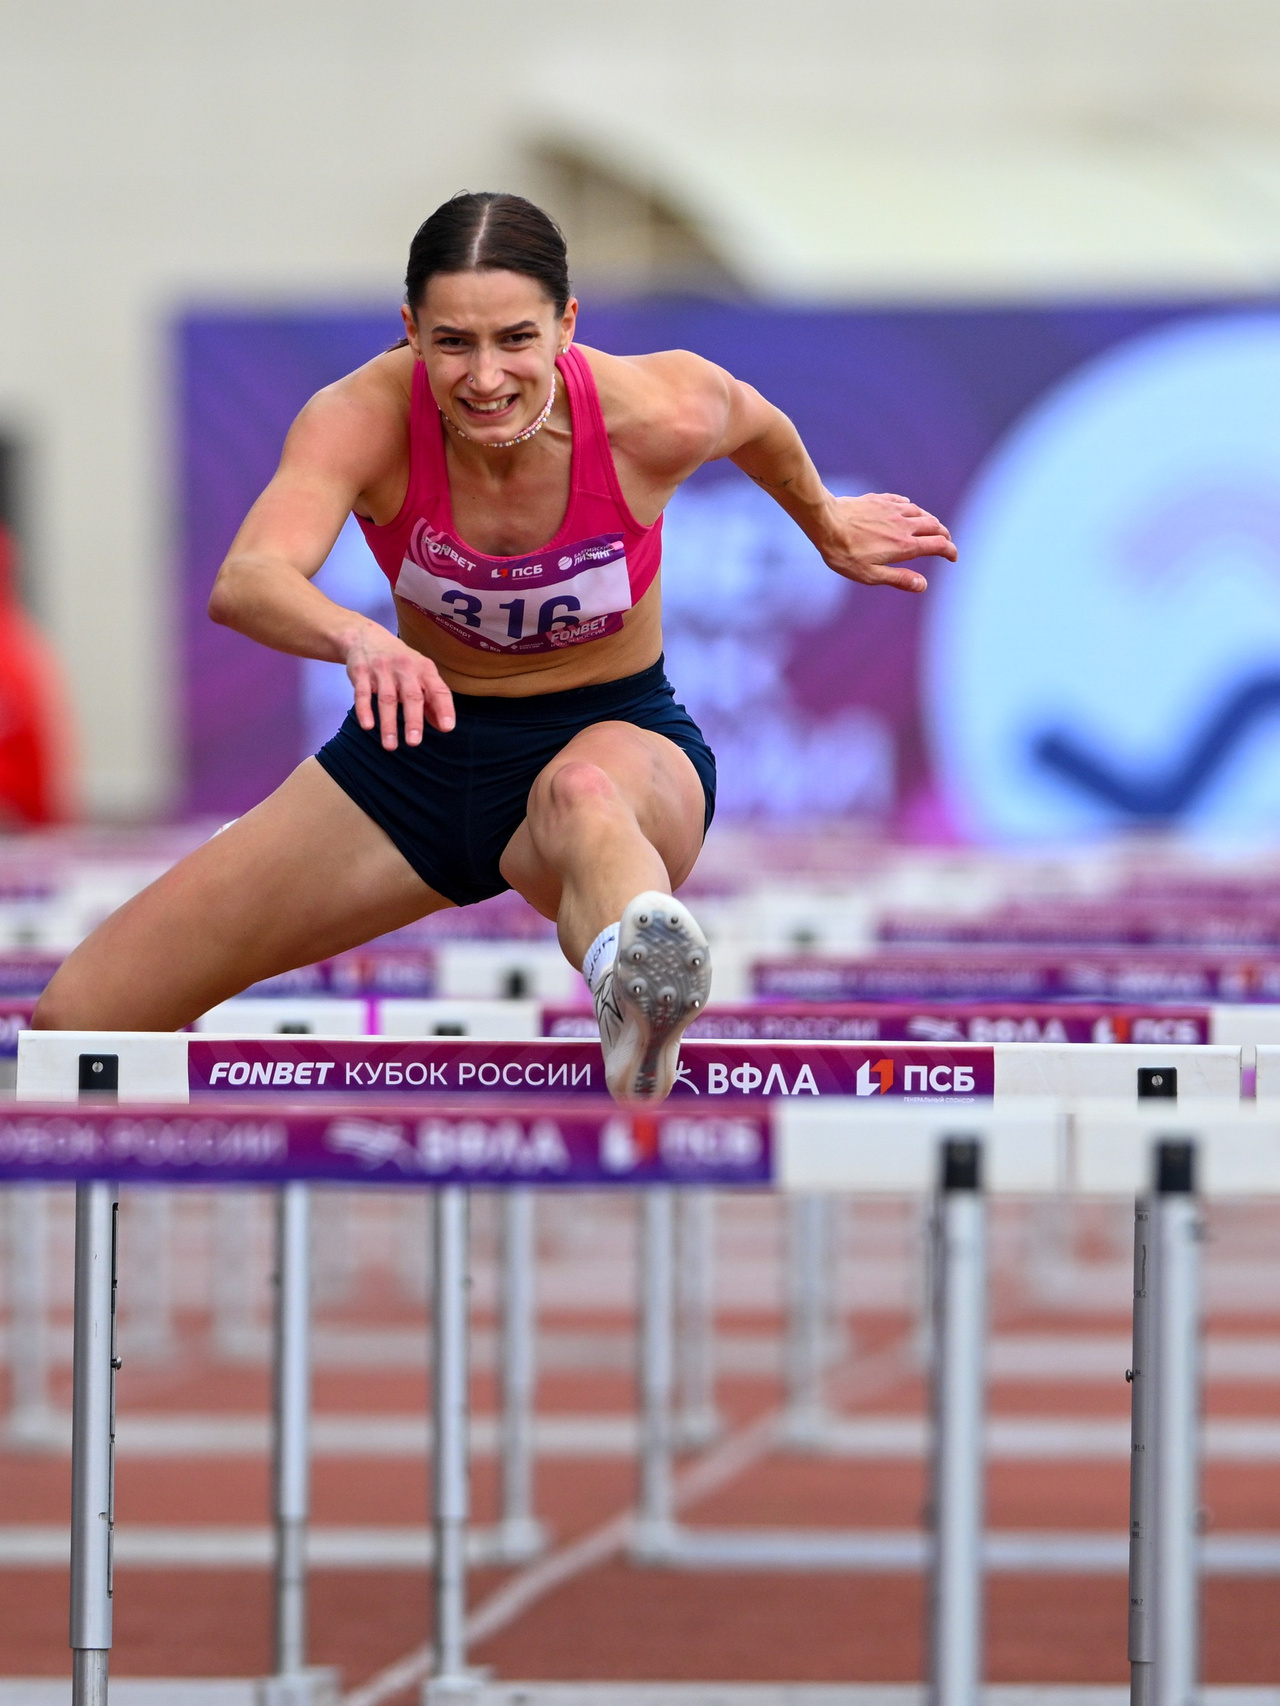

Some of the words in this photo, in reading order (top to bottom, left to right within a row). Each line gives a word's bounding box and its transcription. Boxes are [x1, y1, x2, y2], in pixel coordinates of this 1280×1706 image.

[423, 536, 477, 572] FONBET
[511, 564, 544, 578] ПСБ
[440, 589, 581, 639] 316
[550, 615, 609, 643] FONBET
[208, 1061, 335, 1085] FONBET
[345, 1062, 448, 1086] КУБОК
[458, 1062, 592, 1086] РОССИИ
[708, 1062, 820, 1095] ВФЛА
[904, 1065, 975, 1092] ПСБ
